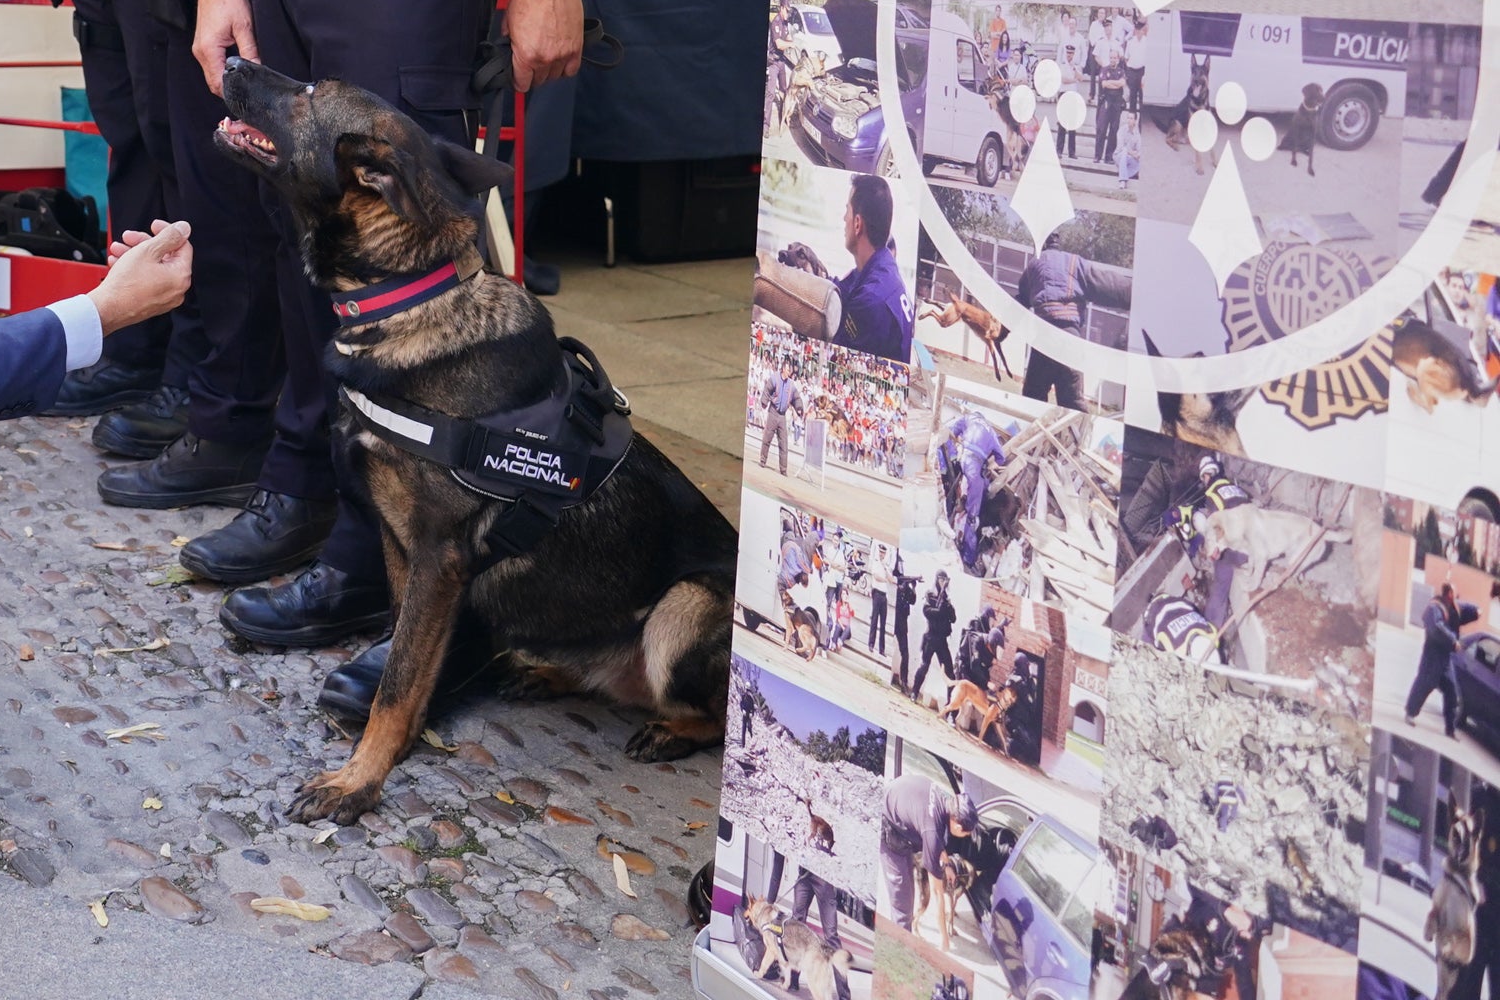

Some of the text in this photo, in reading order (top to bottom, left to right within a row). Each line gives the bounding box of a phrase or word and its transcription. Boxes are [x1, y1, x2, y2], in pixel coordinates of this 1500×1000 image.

[1262, 25, 1291, 44] 091
[1254, 240, 1287, 296] CUERPO
[504, 443, 562, 469] POLICIA
[484, 455, 571, 487] NACIONAL
